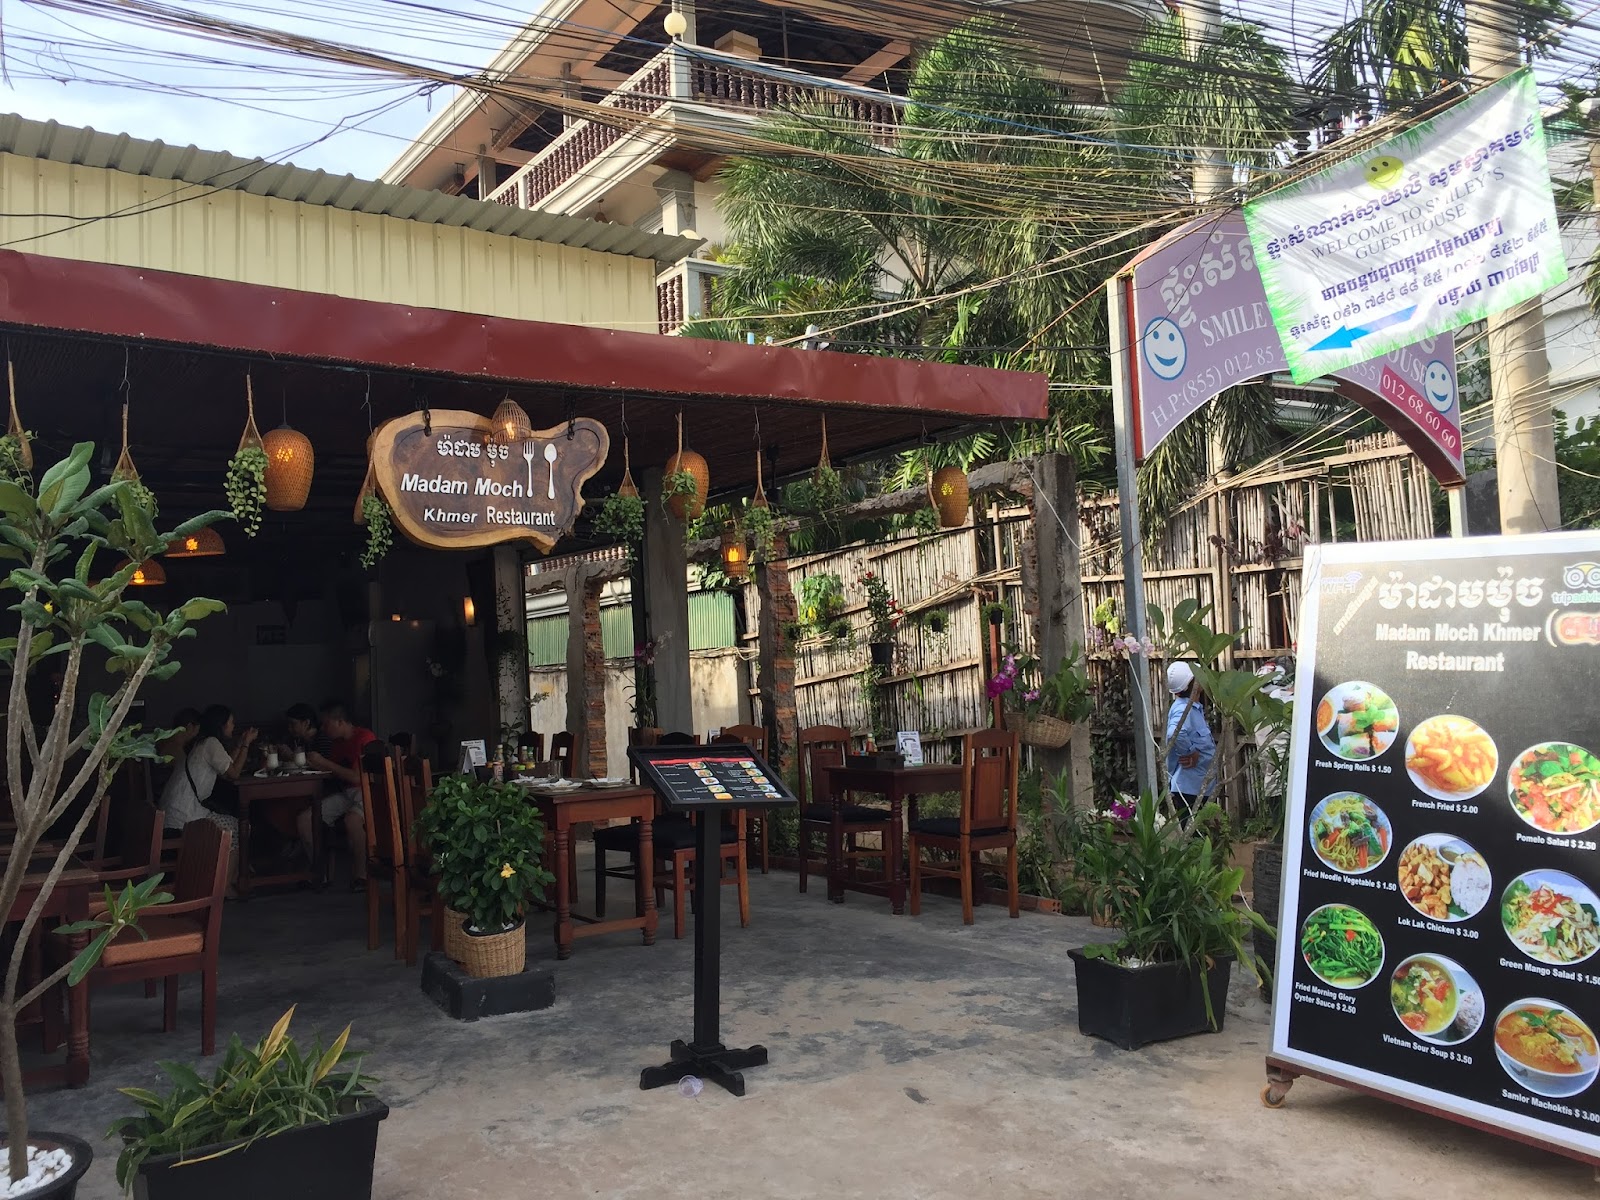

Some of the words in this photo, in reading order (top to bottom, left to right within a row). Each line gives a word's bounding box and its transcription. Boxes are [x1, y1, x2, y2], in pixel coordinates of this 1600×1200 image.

[1311, 216, 1397, 260] WELCOME
[1399, 206, 1422, 225] TO
[1355, 203, 1467, 259] GUESTHOUSE
[1200, 300, 1275, 347] SMILE
[1224, 352, 1252, 376] 012
[1255, 346, 1274, 366] 85
[1383, 374, 1406, 401] 012
[1408, 394, 1424, 414] 68
[1425, 411, 1440, 431] 60
[1441, 429, 1456, 448] 60
[400, 473, 468, 495] Madam
[474, 477, 523, 498] Moch
[424, 507, 477, 524] Khmer
[486, 505, 555, 526] Restaurant
[1376, 623, 1430, 641] Madam
[1435, 623, 1478, 641] Moch
[1483, 622, 1541, 641] Khmer
[1406, 650, 1505, 672] Restaurant
[1315, 760, 1332, 769] Fresh
[1333, 762, 1353, 772] Spring
[1354, 763, 1370, 772] Rolls
[1377, 764, 1391, 774] 1.50
[1412, 800, 1435, 810] French
[1436, 801, 1454, 812] Fried
[1462, 804, 1478, 815] 2.00
[1516, 833, 1545, 845] Pomelo
[1547, 835, 1569, 848] Salad
[1578, 839, 1597, 851] 2.50
[1303, 869, 1318, 878] Fried
[1319, 871, 1342, 882] Noodle
[1343, 875, 1375, 889] Vegetable
[1382, 880, 1397, 891] 1.50
[1398, 917, 1411, 928] Lok
[1412, 919, 1425, 930] Lak
[1426, 921, 1455, 935] Chicken
[1462, 928, 1479, 940] 3.00
[1499, 958, 1524, 971] Green
[1525, 962, 1551, 977] Mango
[1552, 967, 1576, 981] Salad
[1294, 992, 1315, 1005] Oyster
[1315, 996, 1335, 1009] Sauce
[1342, 1003, 1356, 1014] 2.50
[1295, 982, 1310, 992] Fried
[1311, 985, 1337, 1000] Morning
[1338, 991, 1356, 1004] Glory
[1383, 1034, 1411, 1049] Vietnam
[1412, 1041, 1429, 1053] Sour
[1430, 1045, 1448, 1059] Soup
[1456, 1053, 1473, 1065] 3.50
[1502, 1089, 1529, 1104] Samlor
[1531, 1096, 1573, 1116] Machoktis
[1582, 1110, 1600, 1123] 3.00
